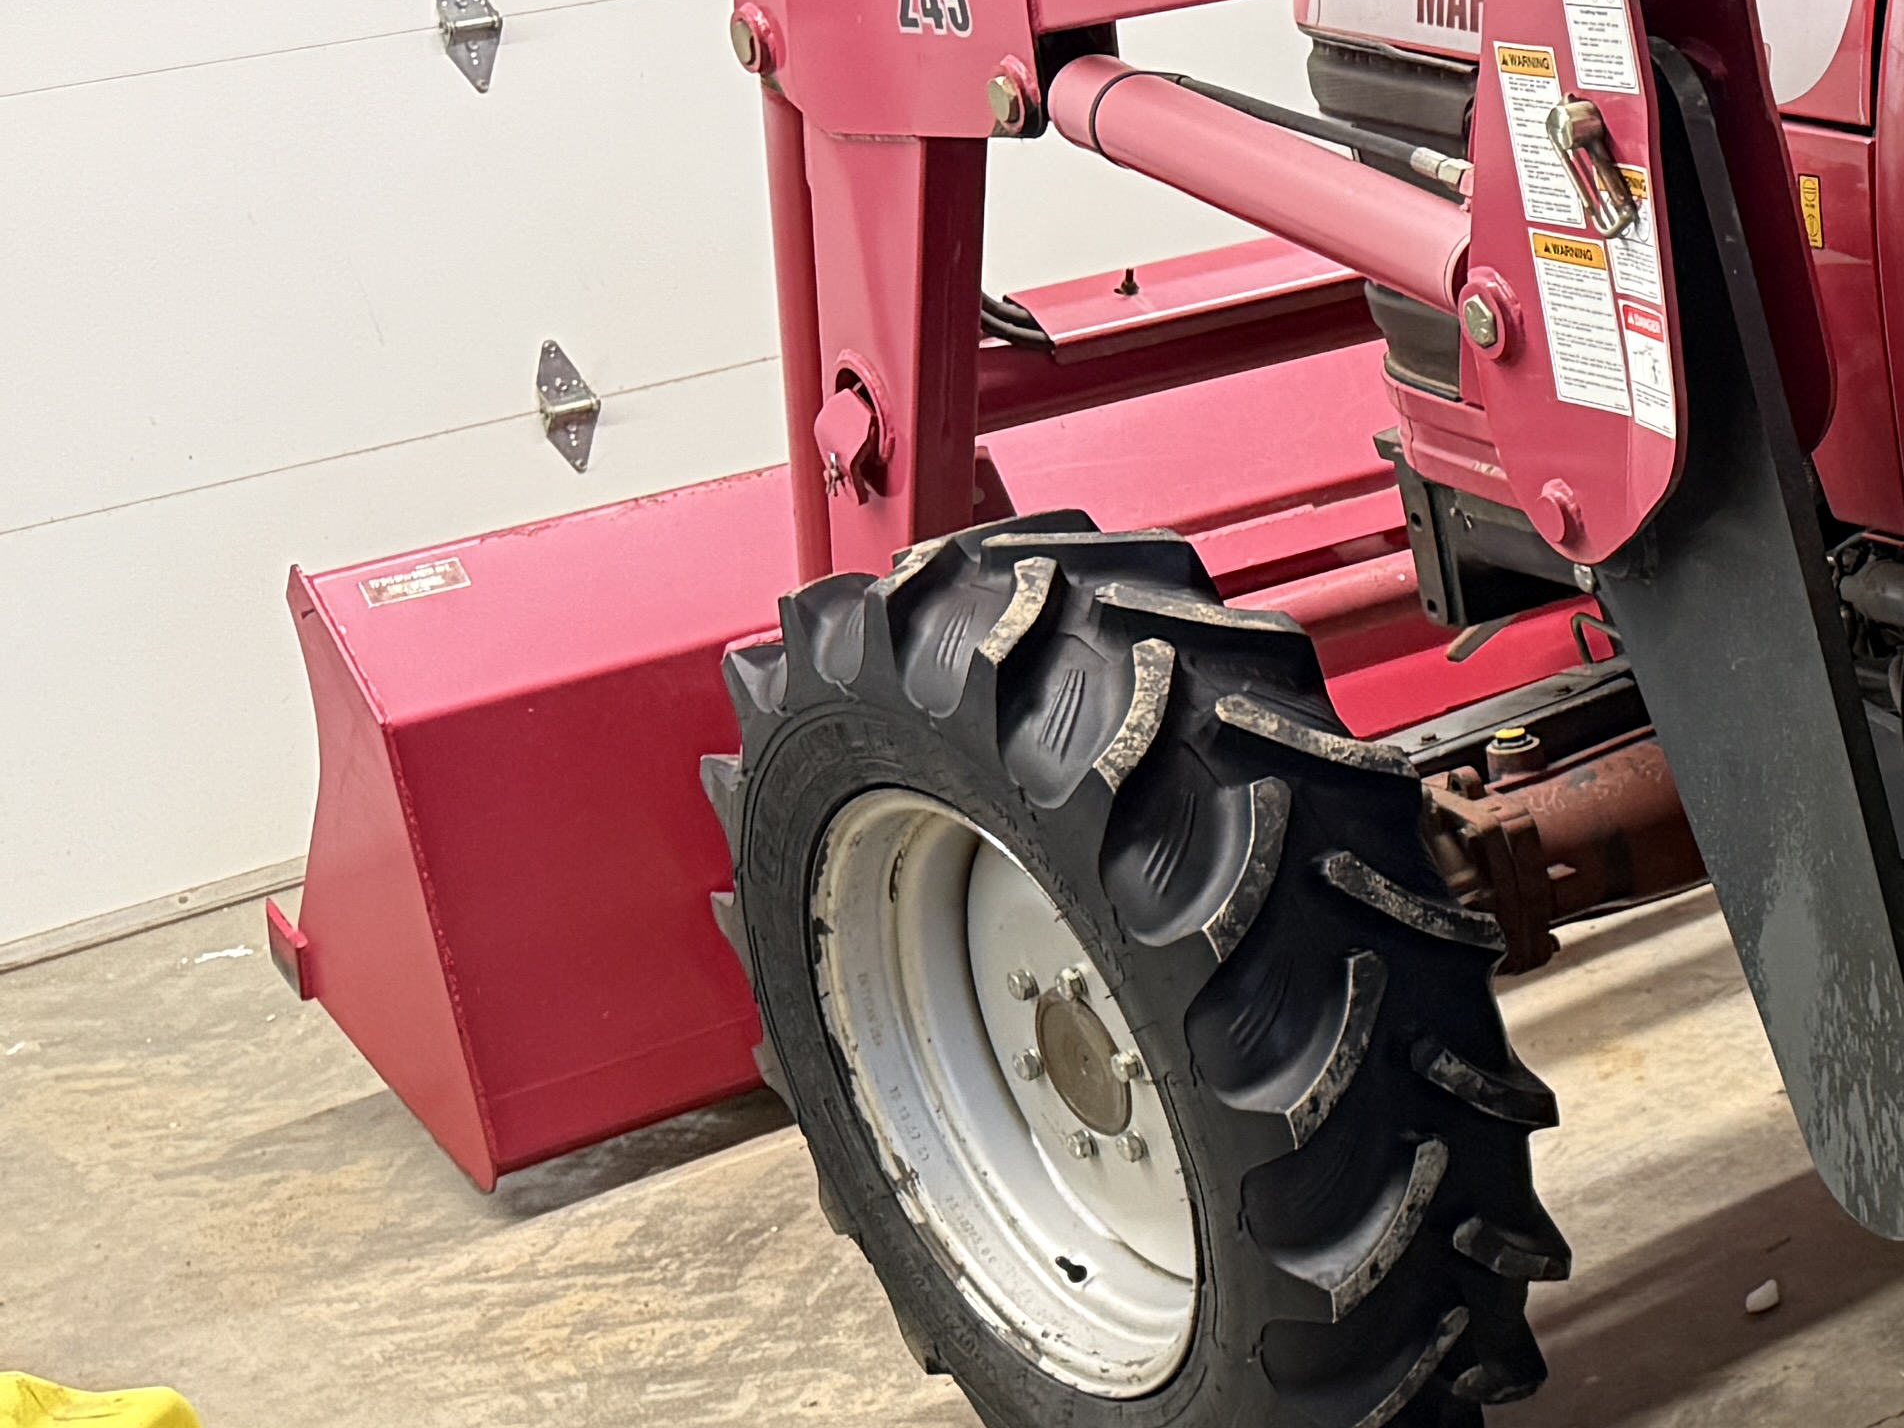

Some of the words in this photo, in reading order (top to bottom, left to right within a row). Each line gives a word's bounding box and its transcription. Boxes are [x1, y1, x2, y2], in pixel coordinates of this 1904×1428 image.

[1508, 53, 1551, 70] WARNING
[1552, 243, 1593, 262] WARNING
[1633, 313, 1662, 334] DANGER
